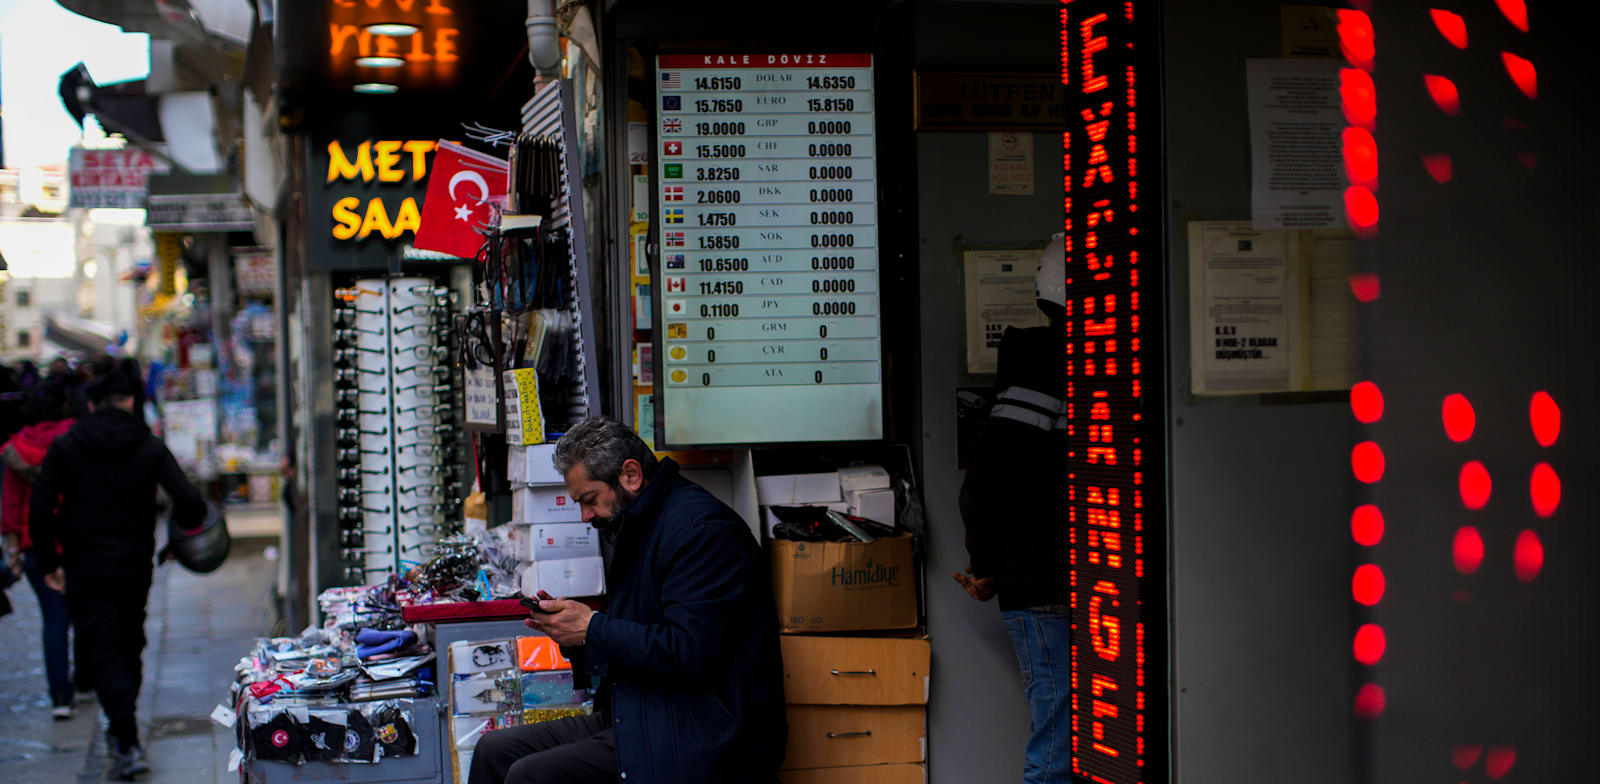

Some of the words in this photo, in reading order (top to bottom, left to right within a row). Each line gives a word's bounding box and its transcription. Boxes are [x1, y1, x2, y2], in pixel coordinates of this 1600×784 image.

[704, 55, 750, 65] KALE
[768, 53, 827, 65] DÖVİZ
[694, 77, 741, 90] 14.6150
[756, 73, 793, 82] DOLAR
[807, 76, 855, 89] 14.6350
[695, 99, 742, 112] 15.7650
[756, 96, 786, 105] EURO
[808, 99, 854, 111] 15.8150
[695, 122, 745, 136] 19.0000
[757, 119, 779, 127] GBP
[808, 121, 851, 134] 0.0000
[696, 145, 745, 158] 15.5000
[757, 141, 779, 150] CHF
[809, 144, 851, 156] 0.0000
[326, 139, 440, 183] MET
[697, 168, 739, 181] 3.8250
[758, 164, 779, 173] SAR
[810, 166, 852, 179] 0.0000
[697, 190, 740, 204] 2.0600
[758, 186, 782, 195] DKK
[810, 189, 852, 202] 0.0000
[331, 196, 421, 240] SAA
[697, 213, 736, 226] 1.4750
[759, 209, 780, 218] SEK
[811, 211, 853, 224] 0.0000
[699, 236, 739, 250] 1.5850
[760, 232, 783, 241] NOK
[811, 234, 854, 248] 0.0000
[699, 258, 748, 272] 10.6500
[760, 254, 783, 263] AUD
[812, 257, 854, 270] 0.0000
[699, 281, 743, 294] 11.4150
[761, 277, 783, 286] CAD
[812, 279, 855, 293] 0.0000
[700, 304, 738, 317] 0.1100
[761, 300, 780, 309] JPY
[813, 302, 855, 315] 0.0000
[707, 327, 715, 341] 0
[761, 322, 787, 331] GRM
[820, 325, 827, 338] 0
[708, 350, 715, 363] 0
[762, 345, 785, 354] CYR
[820, 348, 827, 360] 0
[703, 373, 710, 387] 0
[763, 368, 783, 377] ATA
[815, 370, 822, 384] 0
[831, 560, 900, 586] Hamidiye
